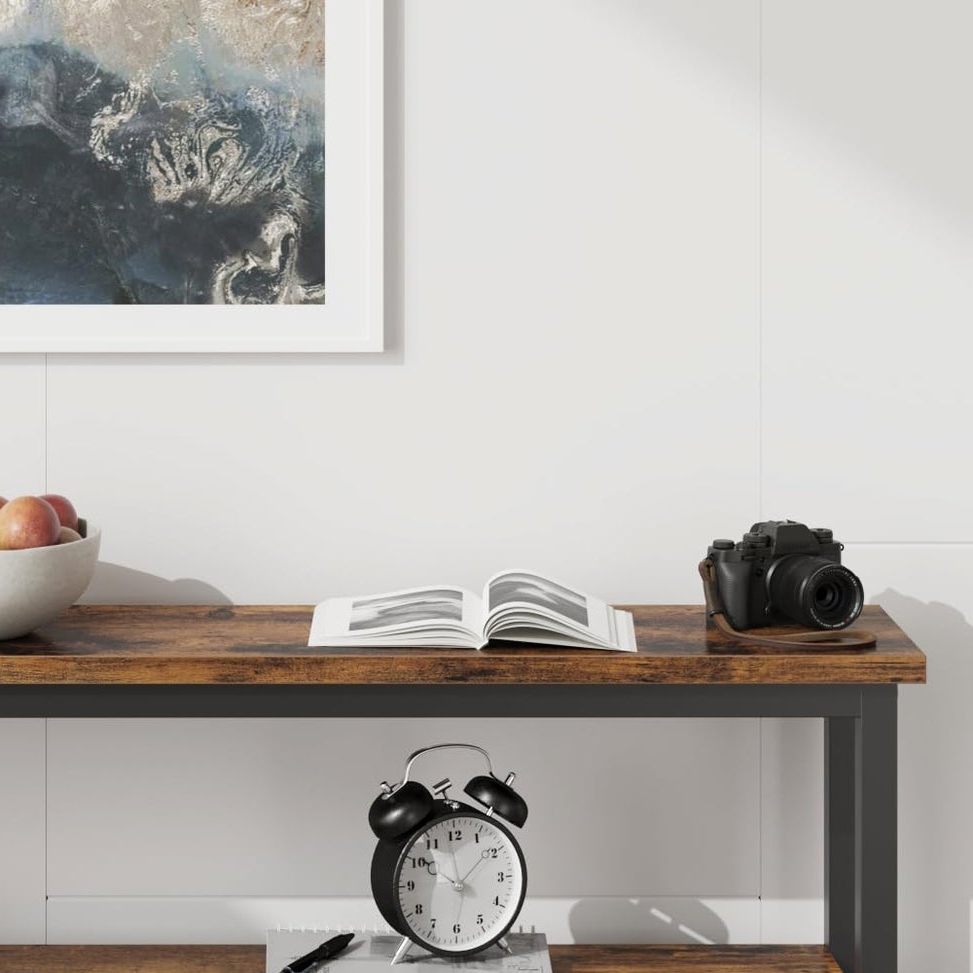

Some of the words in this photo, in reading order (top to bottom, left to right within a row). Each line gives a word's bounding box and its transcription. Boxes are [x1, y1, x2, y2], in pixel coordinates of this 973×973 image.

[448, 830, 462, 841] 12
[474, 833, 480, 843] 1
[426, 839, 438, 850] 11
[491, 848, 498, 859] 2
[411, 857, 425, 868] 10
[497, 872, 504, 882] 3
[407, 881, 415, 891] 9
[492, 895, 499, 906] 4
[415, 904, 423, 915] 8
[430, 918, 437, 929] 7
[476, 914, 483, 924] 5
[453, 924, 460, 934] 6
